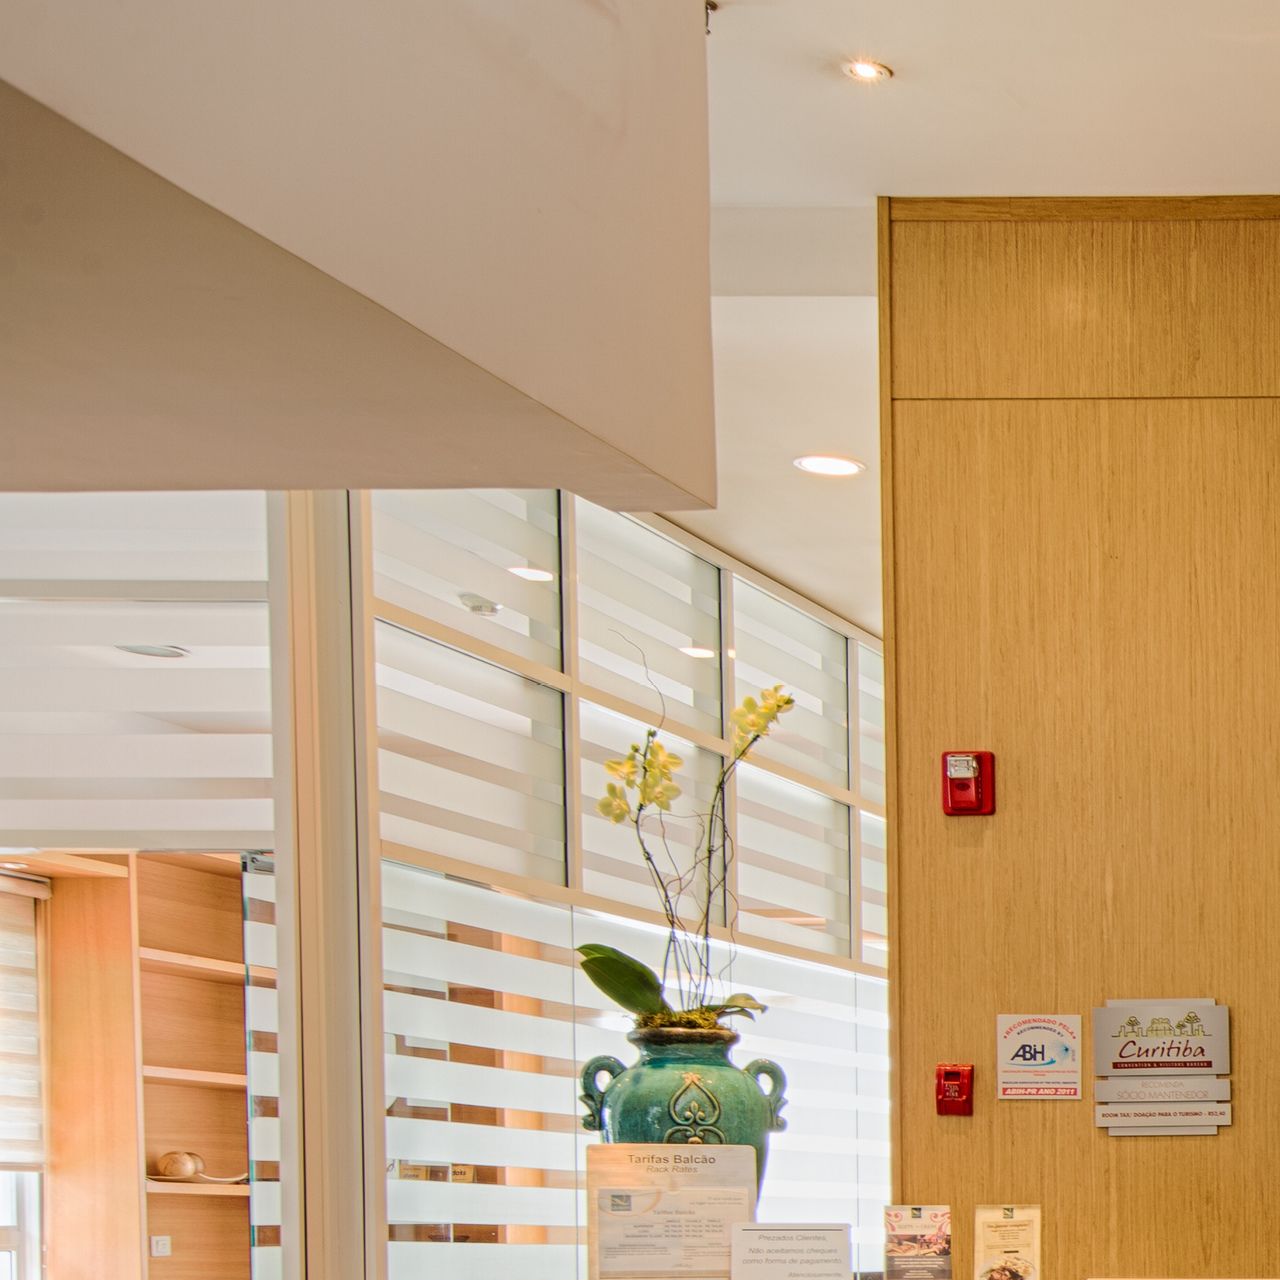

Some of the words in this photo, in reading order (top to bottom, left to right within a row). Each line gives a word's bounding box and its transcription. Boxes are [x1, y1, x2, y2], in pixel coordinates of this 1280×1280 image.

[1005, 1017, 1057, 1036] RECOMENDADO
[1058, 1022, 1074, 1036] PELA
[1118, 1039, 1206, 1059] Curitiba
[1150, 1091, 1209, 1099] MANTENEDOR
[628, 1154, 669, 1164] Tarifas
[673, 1154, 716, 1164] Balcão
[672, 1165, 698, 1173] Rates
